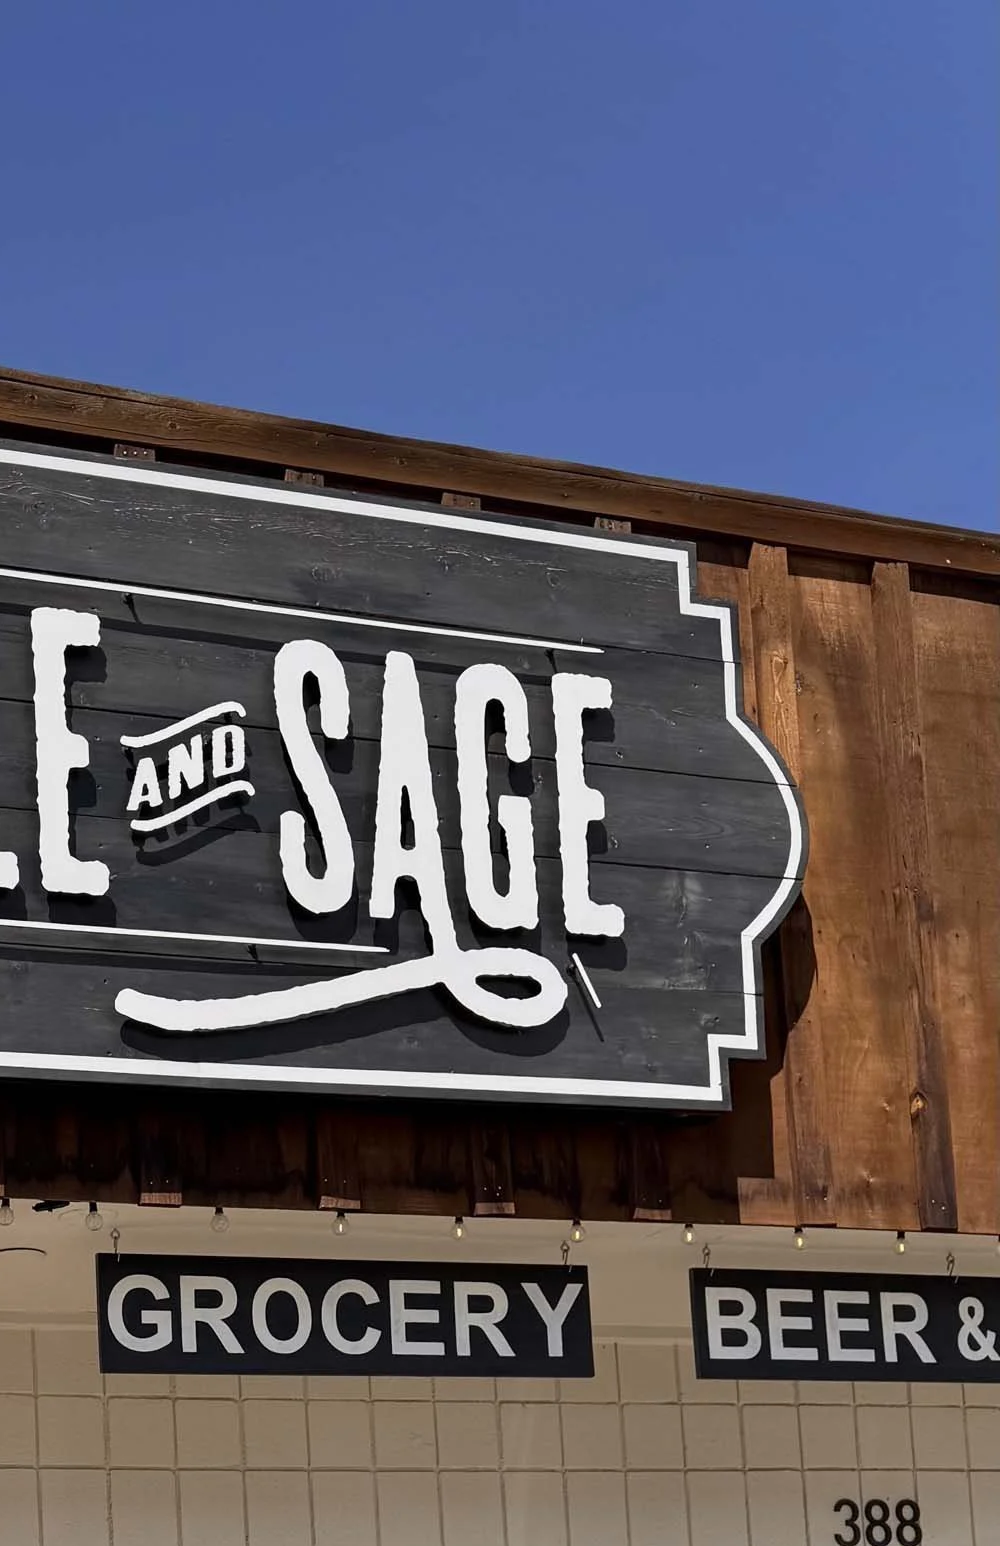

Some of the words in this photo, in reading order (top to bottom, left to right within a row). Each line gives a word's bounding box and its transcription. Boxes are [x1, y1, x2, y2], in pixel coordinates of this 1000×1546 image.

[126, 724, 246, 812] AND
[115, 639, 625, 1032] SAGE
[107, 1274, 583, 1357] GROCERY
[704, 1286, 937, 1364] BEER
[957, 1296, 1000, 1361] &
